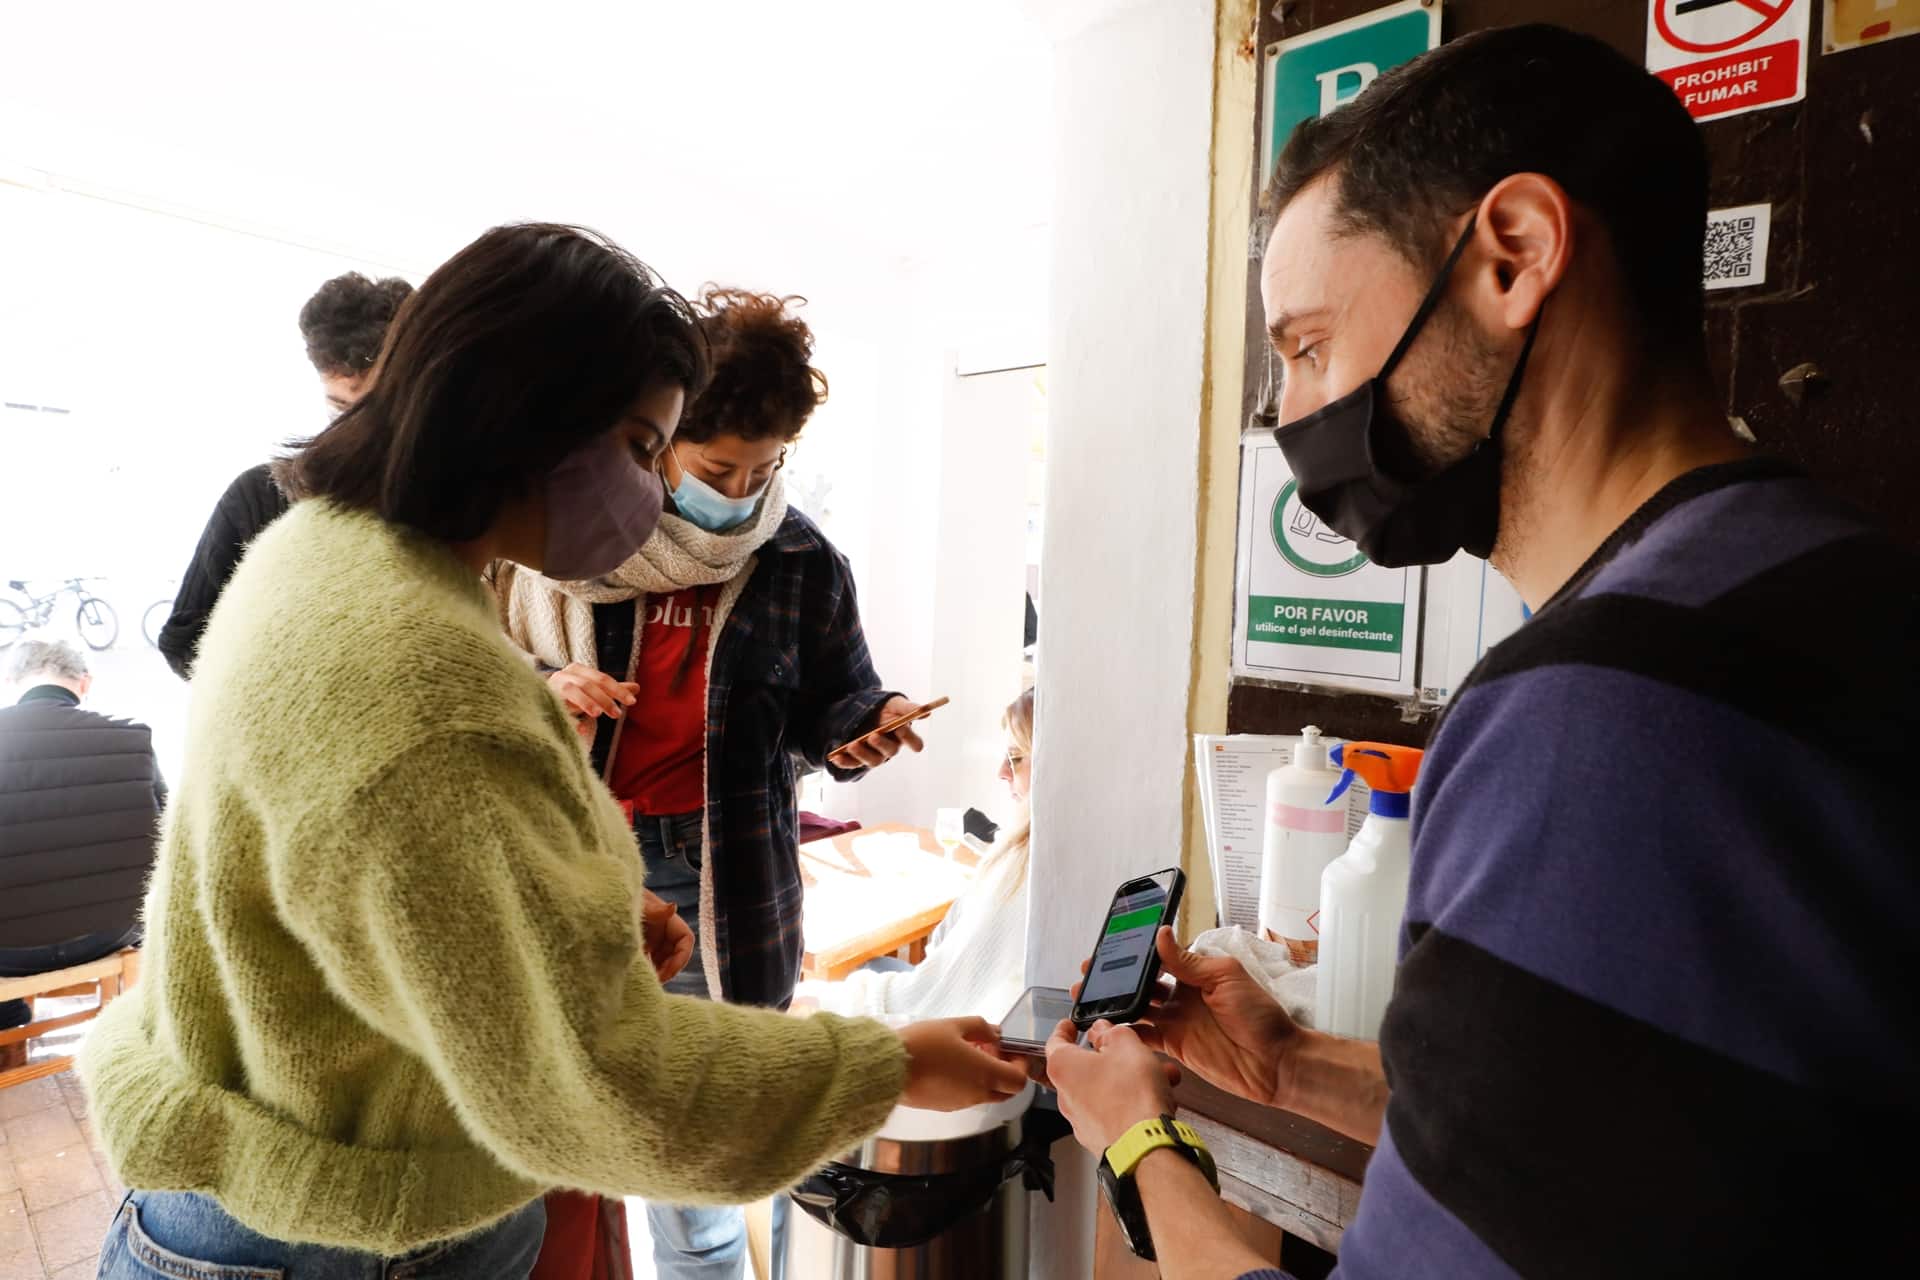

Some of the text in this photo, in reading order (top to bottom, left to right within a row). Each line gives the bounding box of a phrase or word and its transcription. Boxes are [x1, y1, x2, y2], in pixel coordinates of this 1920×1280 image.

[1684, 80, 1758, 107] FUMAR
[1273, 605, 1369, 624] POR FAVOR
[1255, 622, 1394, 641] utilice el gel desinfectante
